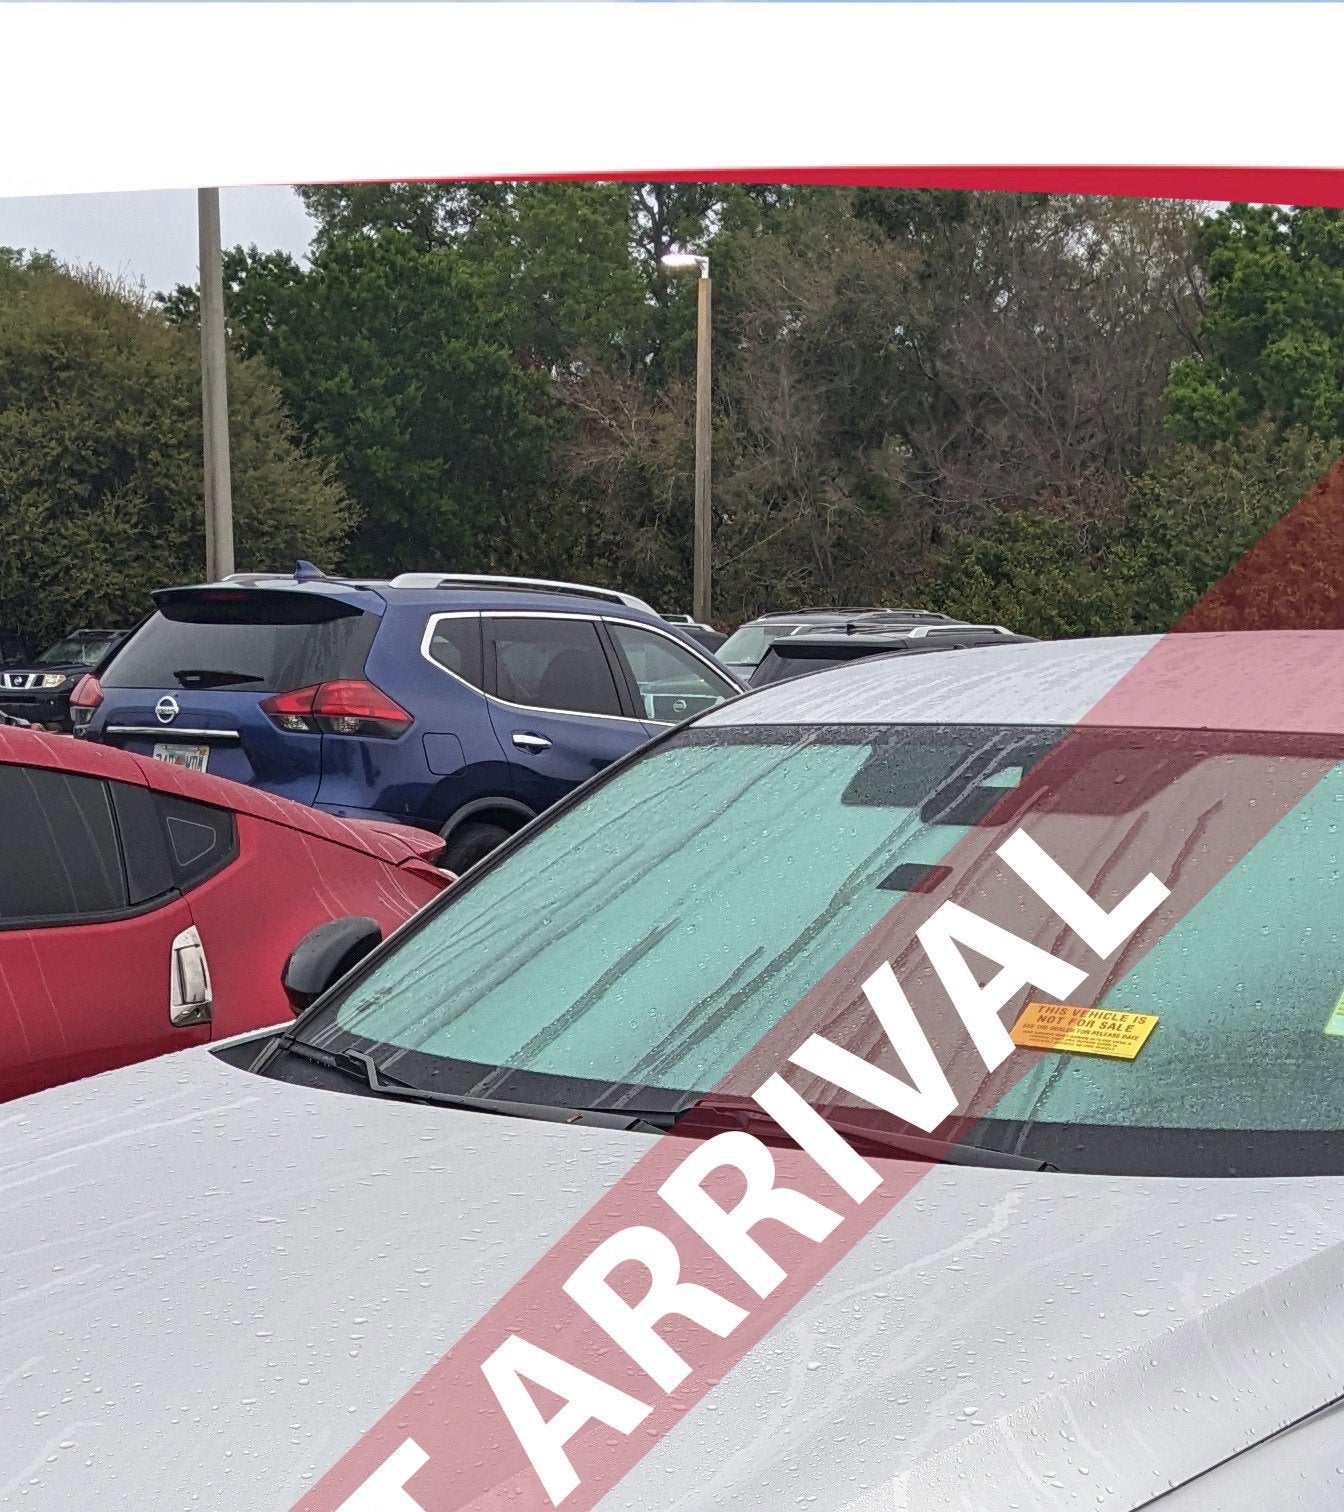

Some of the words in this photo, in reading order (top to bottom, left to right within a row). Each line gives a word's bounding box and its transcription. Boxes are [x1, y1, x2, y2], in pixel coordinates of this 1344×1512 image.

[1036, 1015, 1065, 1024] NOT
[1067, 1018, 1096, 1028] FOR
[1099, 1021, 1135, 1033] SALE
[1037, 1005, 1068, 1016] THIS
[1072, 1009, 1130, 1023] VEHICLE
[1132, 1015, 1148, 1025] IS
